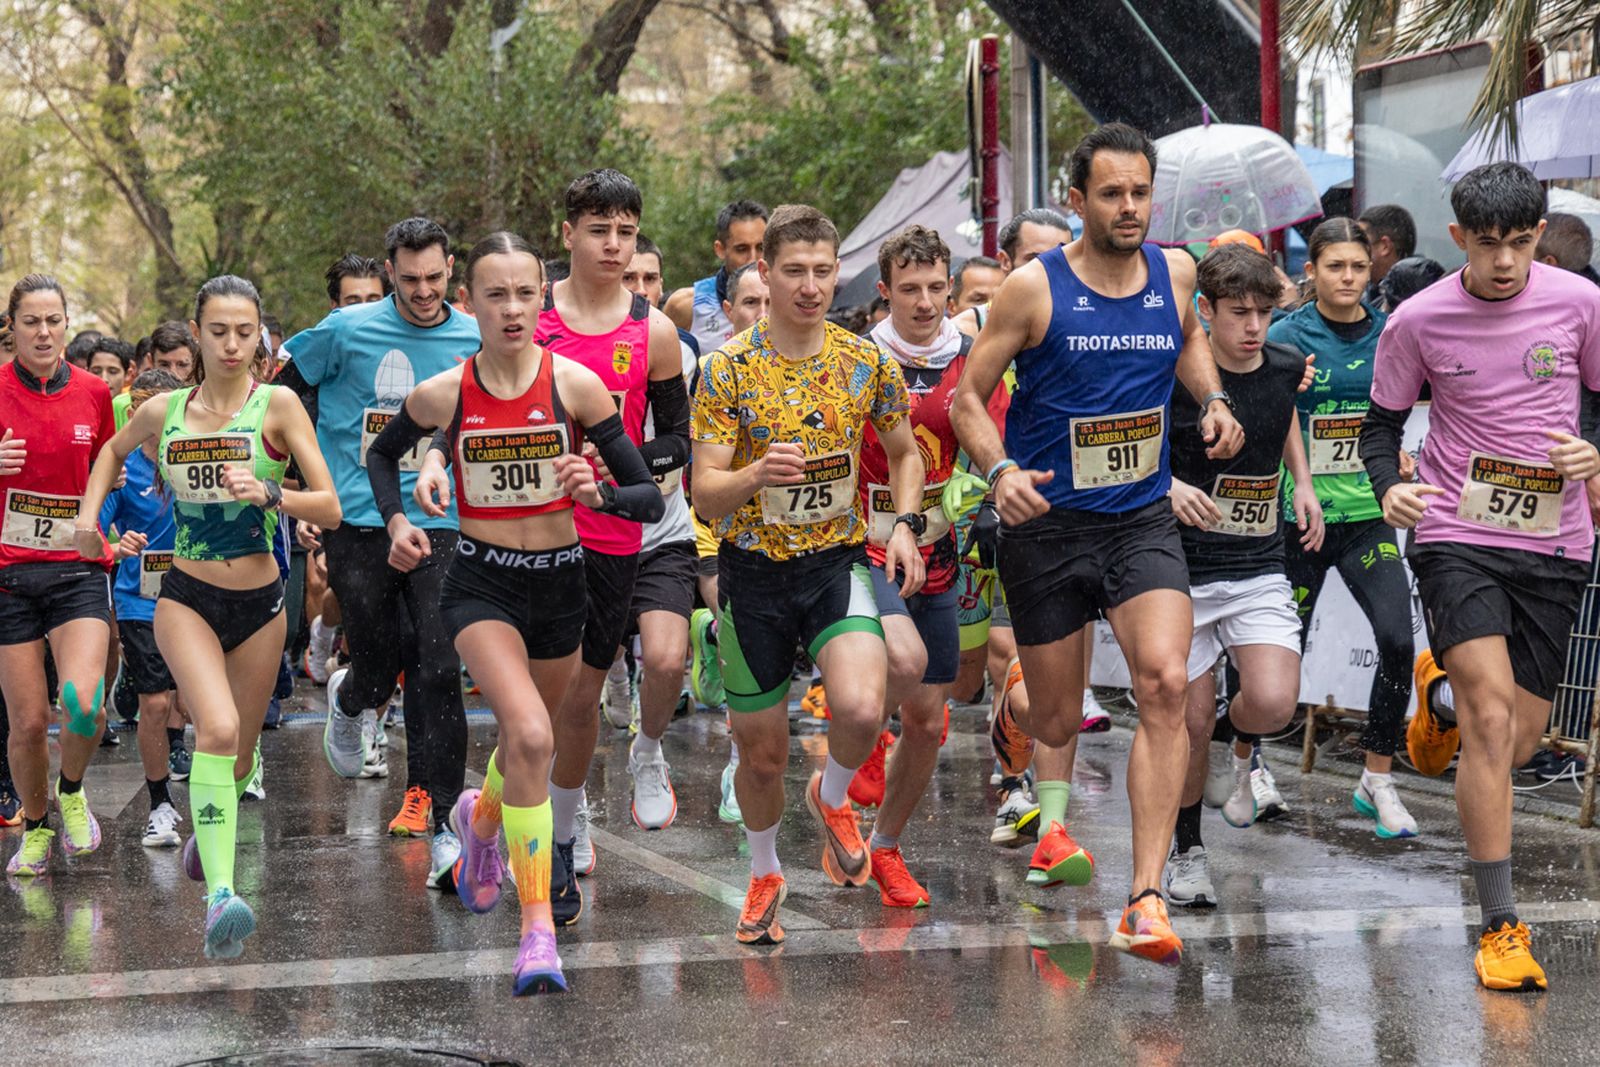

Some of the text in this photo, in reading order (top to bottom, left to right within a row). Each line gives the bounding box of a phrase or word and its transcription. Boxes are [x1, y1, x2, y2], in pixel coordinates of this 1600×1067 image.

[1066, 334, 1175, 351] TROTASIERRA
[371, 414, 383, 423] IES
[465, 414, 486, 424] vive
[1080, 415, 1158, 434] IES San Juan Bosco
[1317, 420, 1328, 428] IES
[369, 423, 375, 432] V
[1079, 424, 1160, 446] V CARRERA POPULAR
[1315, 429, 1322, 438] V
[1322, 427, 1353, 438] CARRERA
[171, 438, 245, 451] IES San Juan Bosco
[468, 433, 556, 449] IES San Juan Bosco
[169, 448, 248, 463] V CARRERA POPULAR
[467, 444, 560, 461] V CARRERA POPULAR
[1107, 443, 1139, 472] 911
[823, 457, 846, 468] Bosco
[1478, 459, 1560, 479] IES San Juan Bosco
[490, 462, 541, 491] 304
[815, 466, 849, 481] POPULAR
[1475, 469, 1560, 492] V CARRERA POPULAR
[1224, 479, 1236, 488] IES
[1239, 480, 1251, 488] San
[15, 494, 77, 508] IES San Juan Bosco
[787, 483, 833, 512] 725
[877, 491, 890, 500] IES
[1219, 488, 1226, 496] V
[1226, 488, 1259, 498] CARRERA
[12, 502, 78, 518] V CARRERA POPULAR
[875, 500, 882, 510] V
[1488, 488, 1539, 519] 579
[1231, 501, 1270, 524] 550
[34, 518, 54, 539] 12
[484, 548, 552, 569] NIKE
